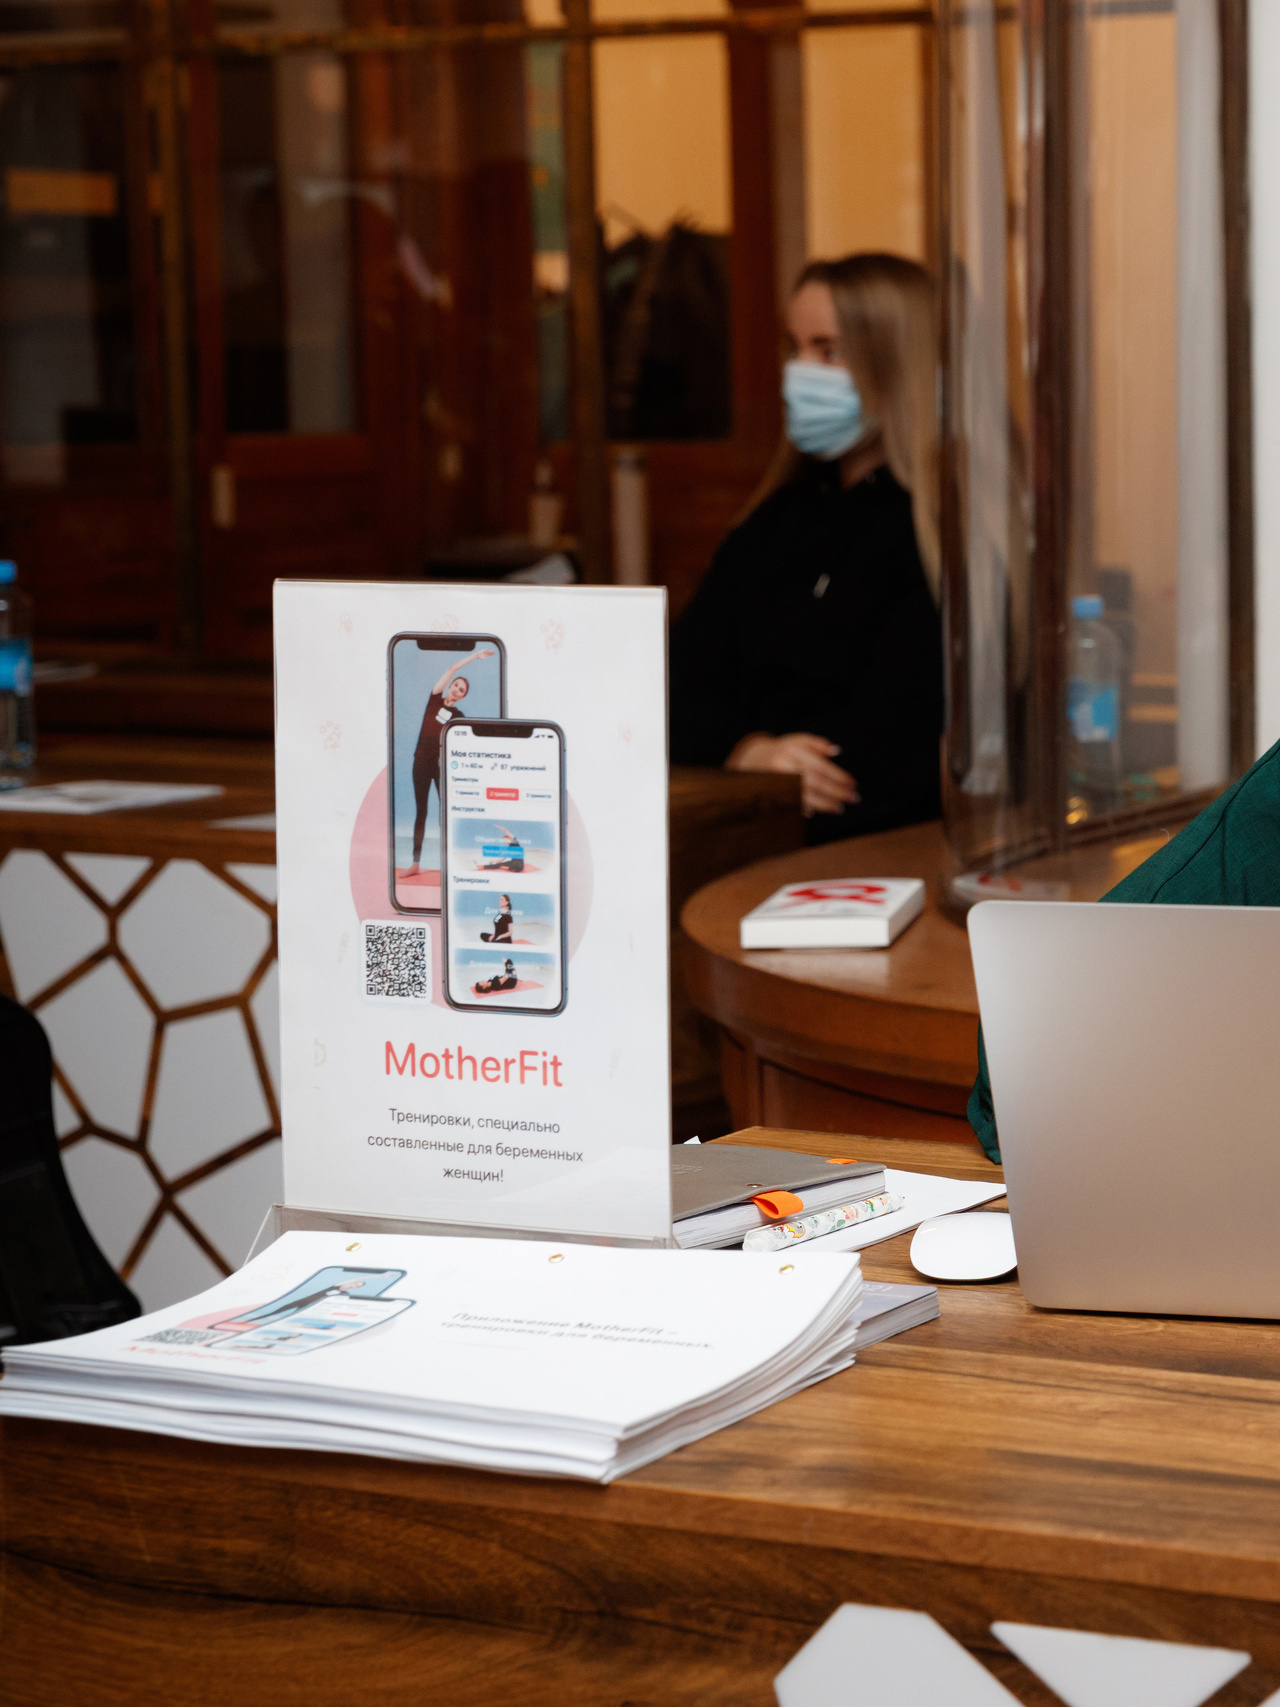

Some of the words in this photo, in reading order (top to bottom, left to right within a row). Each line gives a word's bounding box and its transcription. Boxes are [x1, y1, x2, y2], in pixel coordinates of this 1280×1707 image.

[451, 750, 467, 758] Моя
[451, 805, 486, 813] Инструктаж
[453, 876, 490, 884] Тренировки
[384, 1040, 563, 1088] MotherFit
[388, 1107, 474, 1130] Тренировки,
[476, 1115, 560, 1134] специально
[367, 1134, 464, 1153] составленные
[467, 1142, 492, 1156] для
[495, 1142, 584, 1163] беременных
[442, 1166, 504, 1183] женщин!
[573, 1322, 664, 1335] MotherFit
